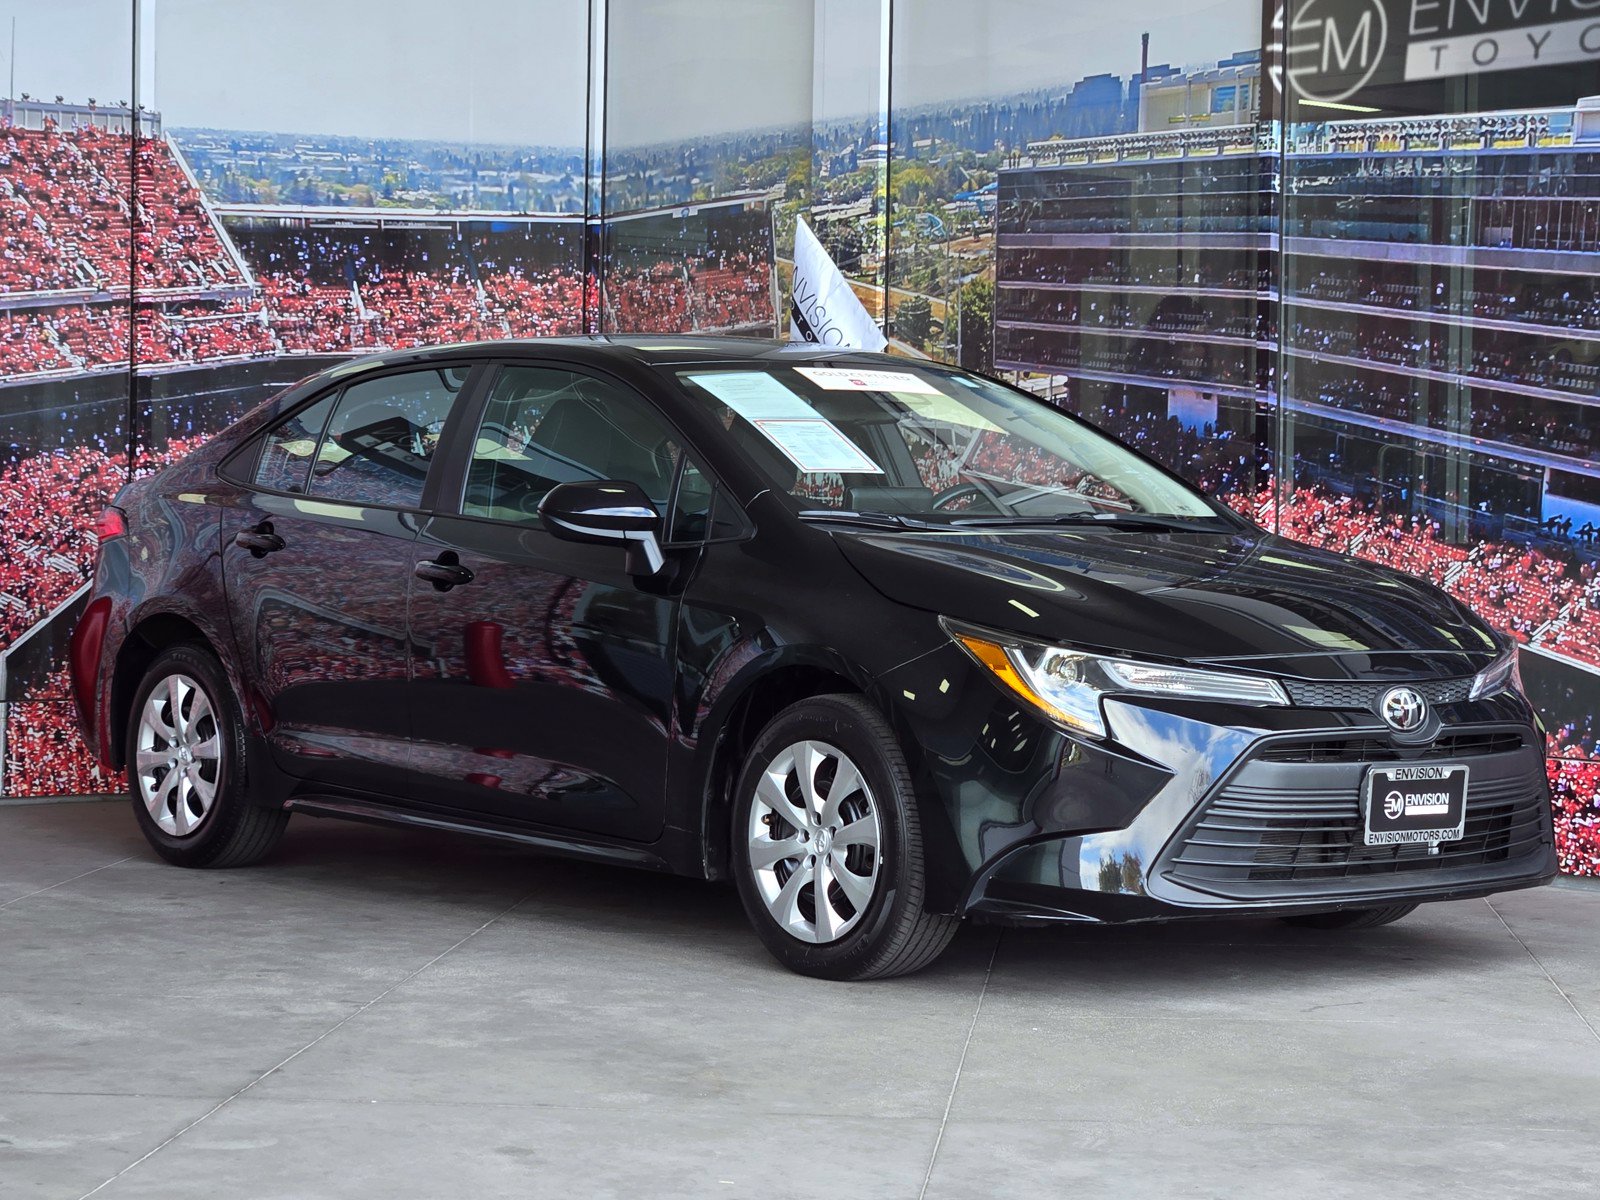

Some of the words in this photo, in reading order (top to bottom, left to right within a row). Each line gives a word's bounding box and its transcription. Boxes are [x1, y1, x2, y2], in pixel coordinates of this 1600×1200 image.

[1395, 767, 1443, 780] ENVISION
[1405, 792, 1450, 806] ENVISION
[1368, 829, 1460, 844] ENVISIONMOTORS.COM
